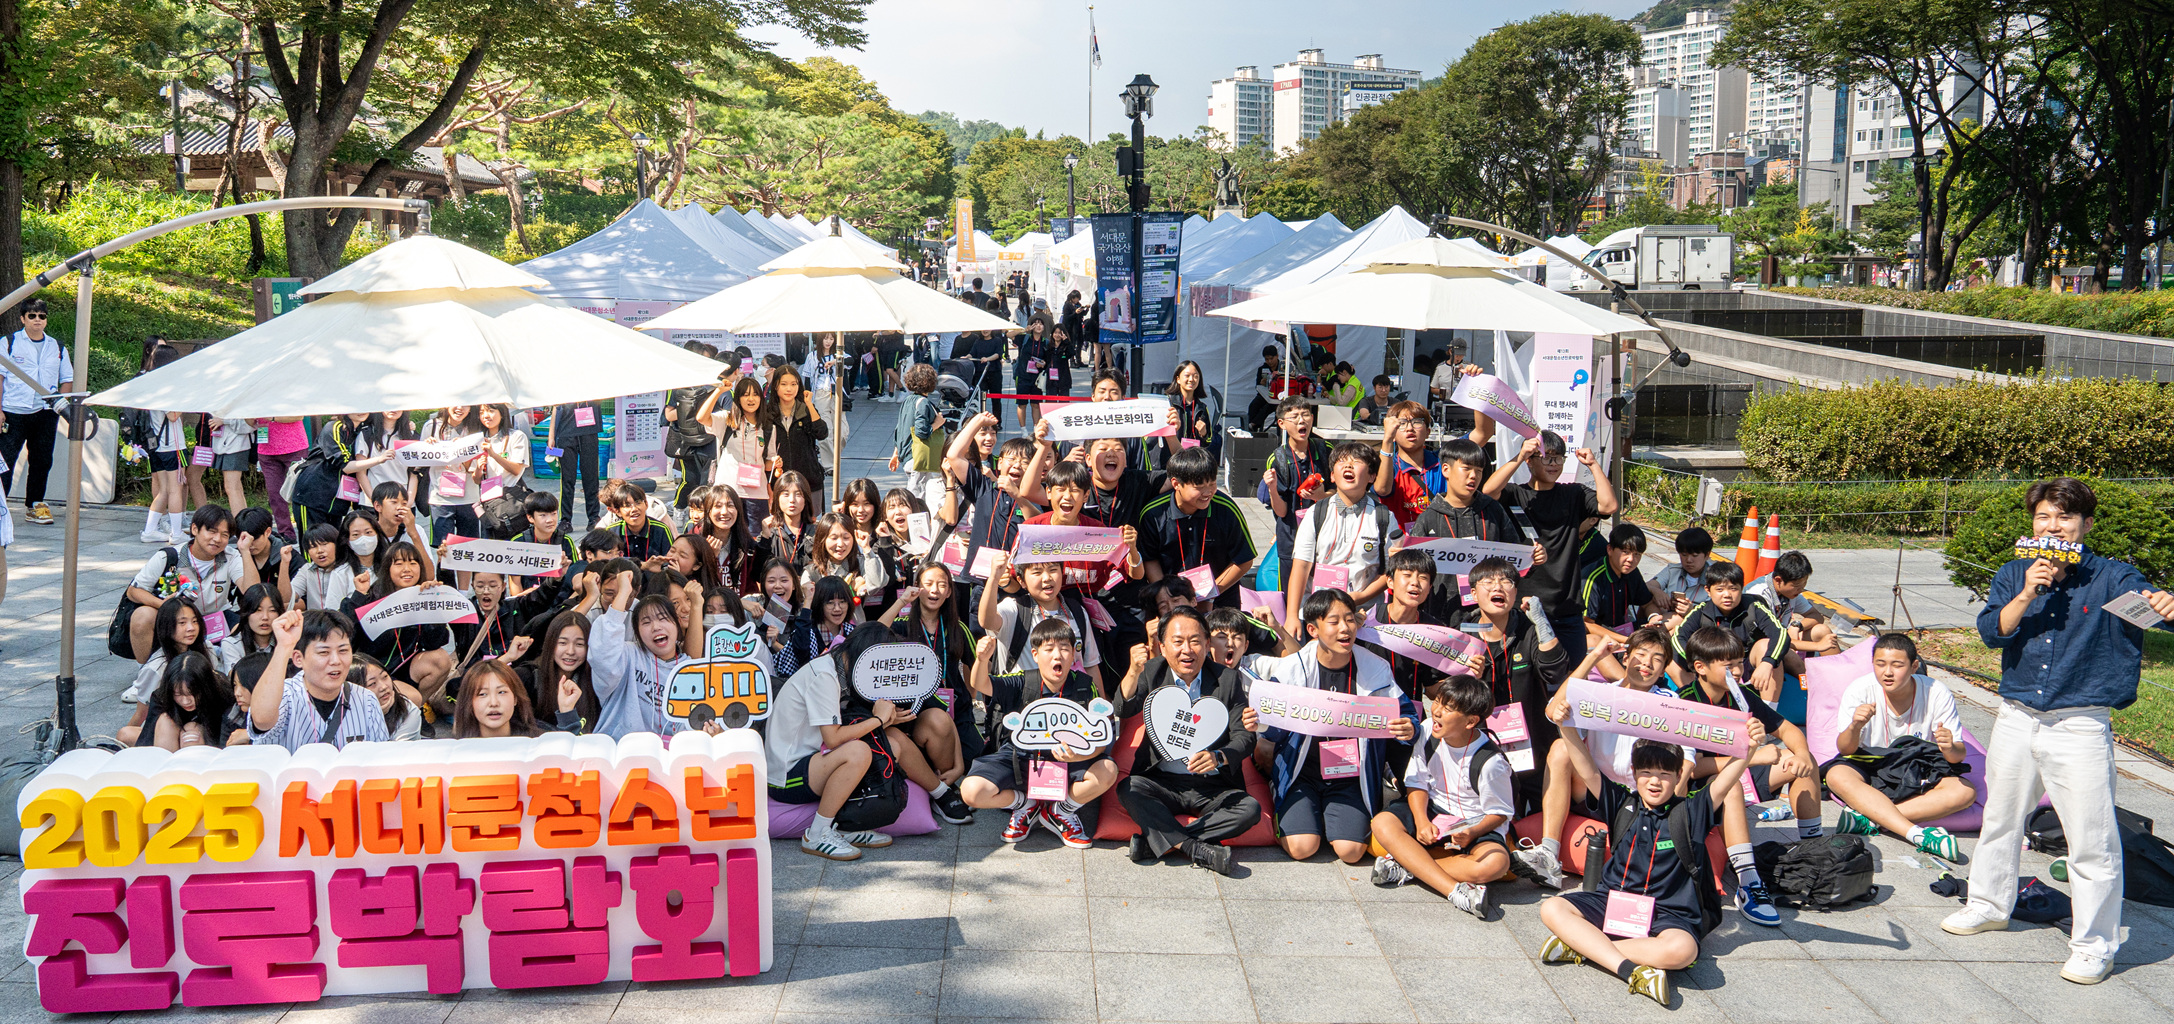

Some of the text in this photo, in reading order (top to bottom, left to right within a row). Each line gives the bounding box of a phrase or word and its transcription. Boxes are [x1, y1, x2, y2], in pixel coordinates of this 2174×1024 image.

[1100, 232, 1127, 243] 서대문
[1096, 242, 1131, 253] 국가유산
[1105, 255, 1124, 266] 야행
[1544, 400, 1578, 409] 무대 행사에
[1062, 413, 1154, 427] 홍은청소년문화의집
[1548, 412, 1574, 420] 함께하는
[401, 451, 419, 461] 행복
[421, 451, 450, 460] 200%
[2015, 537, 2083, 553] 서대문청소년
[452, 548, 555, 568] 행복 200% 서대문!
[1437, 550, 1478, 564] 200%
[2014, 548, 2082, 564] 진로박람회
[369, 600, 470, 624] 서대문진로직업체험지원센터
[869, 656, 925, 672] 서대문청소년
[872, 674, 919, 689] 진로박람회
[1175, 708, 1193, 723] 꿈을
[1259, 696, 1388, 730] 행복 200% 서대문!
[1171, 721, 1197, 738] 현실로
[1578, 699, 1612, 722] 행복
[1617, 709, 1669, 732] 200%
[1674, 719, 1735, 745] 서대문!
[1166, 734, 1191, 751] 만드는
[20, 763, 757, 870] 2025 서대문청소년
[23, 845, 761, 1013] 진로박람회
